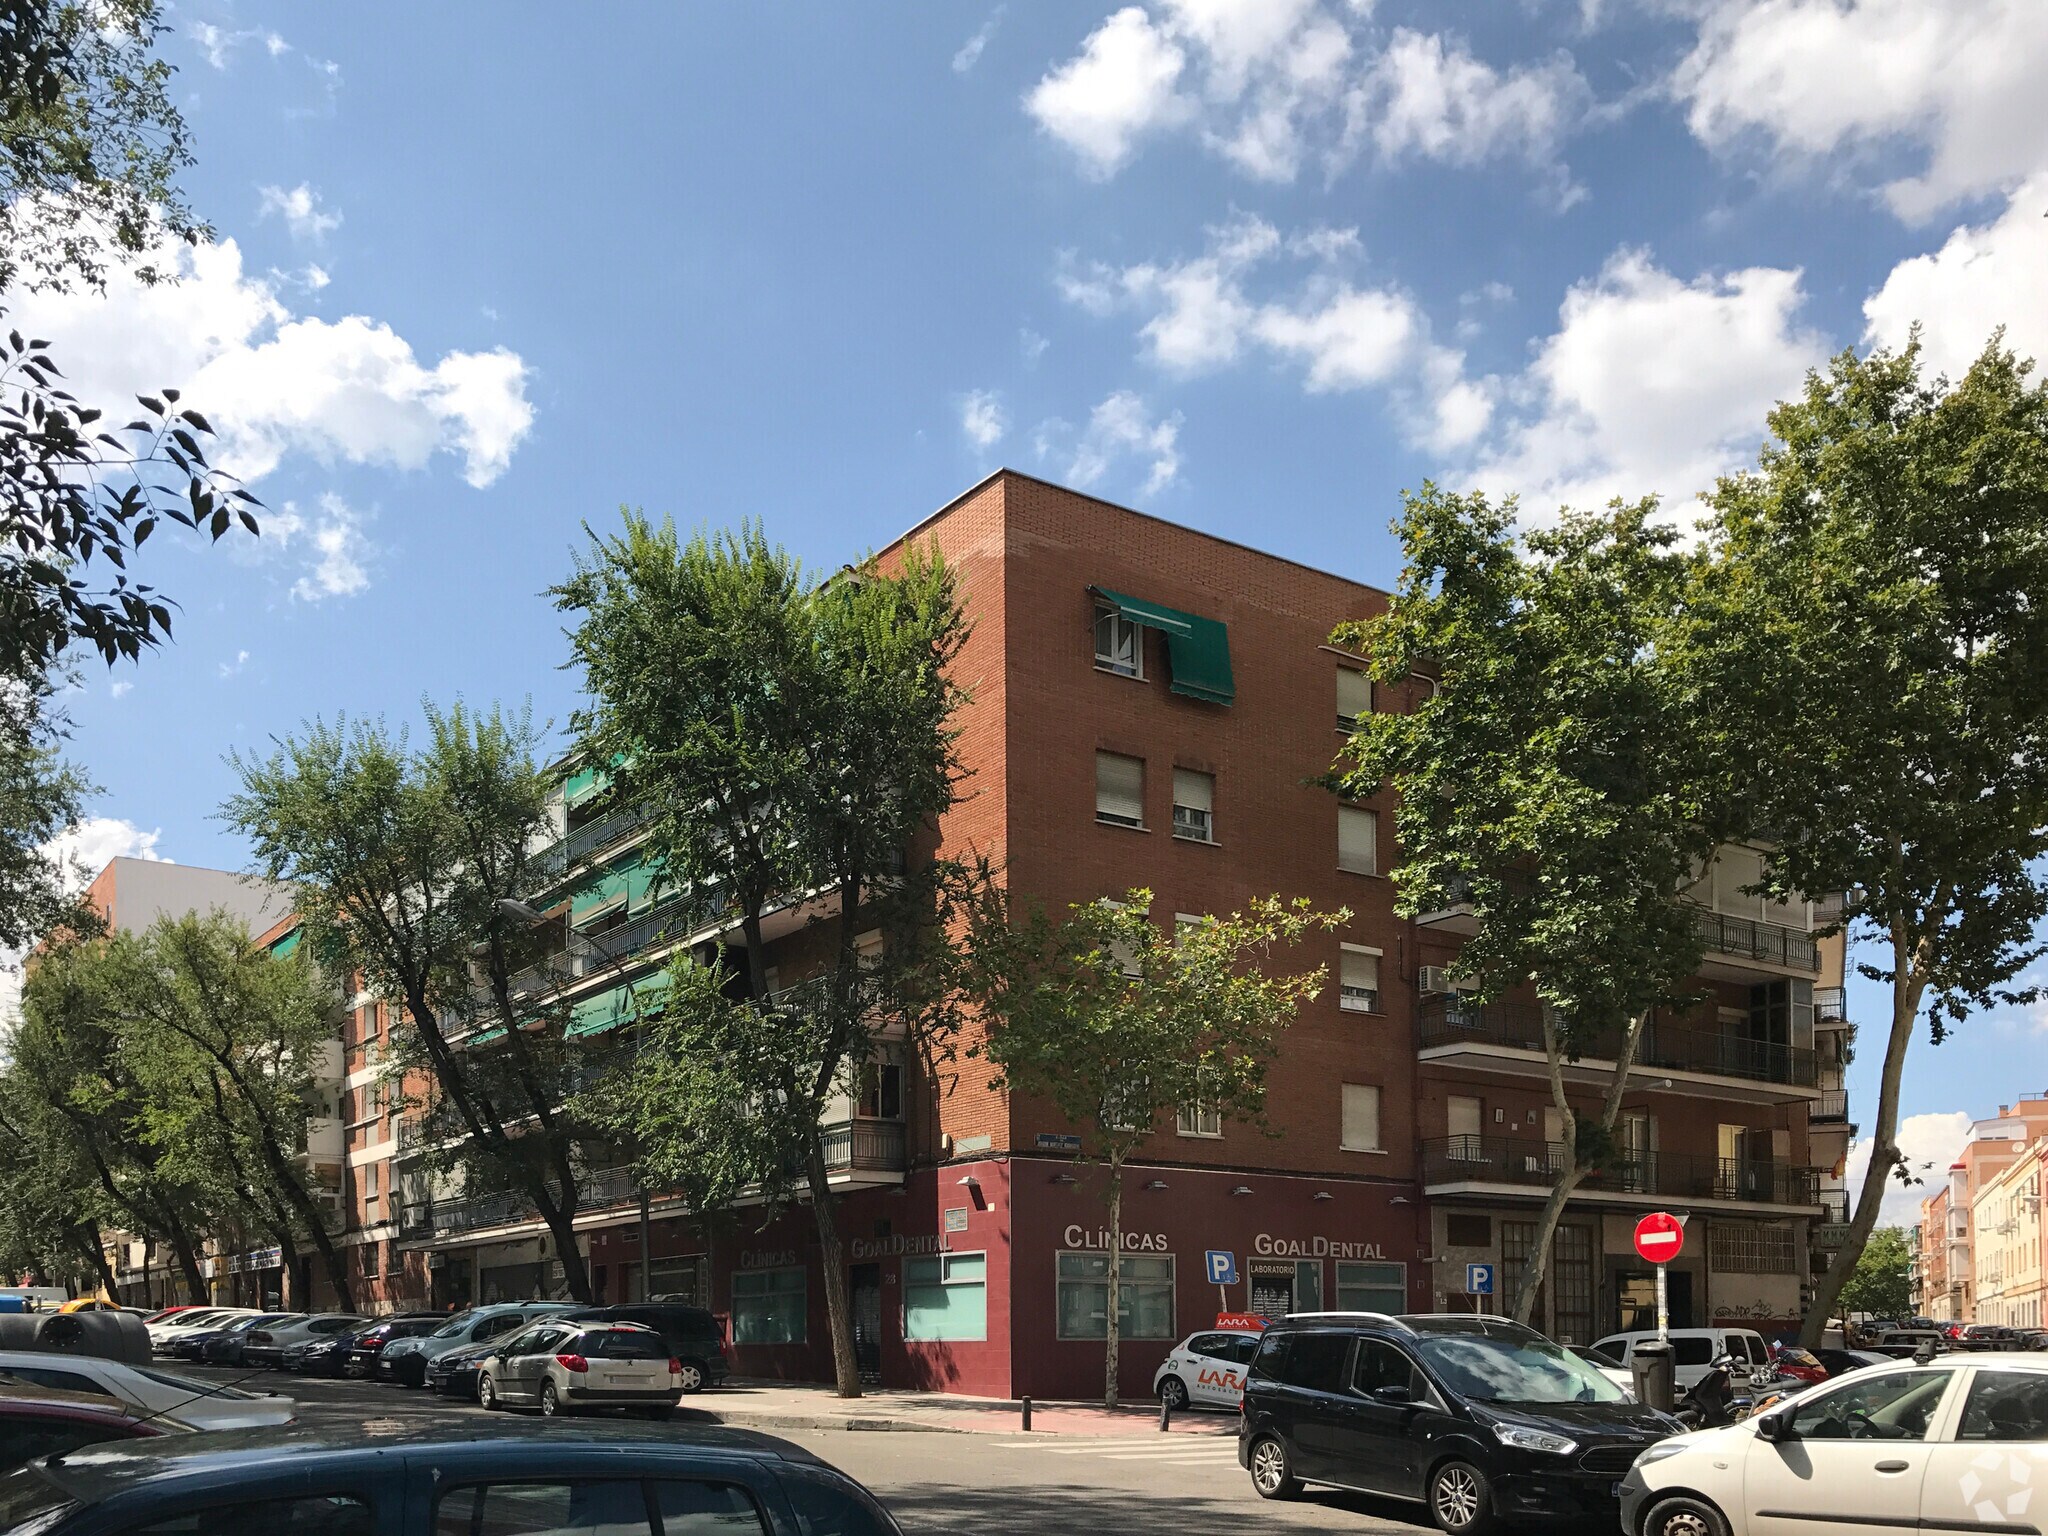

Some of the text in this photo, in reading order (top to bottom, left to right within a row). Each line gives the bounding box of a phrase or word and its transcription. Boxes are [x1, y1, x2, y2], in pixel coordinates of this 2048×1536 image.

[1212, 1254, 1230, 1280] P
[1250, 1264, 1295, 1274] LABORATORIO
[1472, 1267, 1489, 1291] P
[1217, 1318, 1250, 1326] LARA
